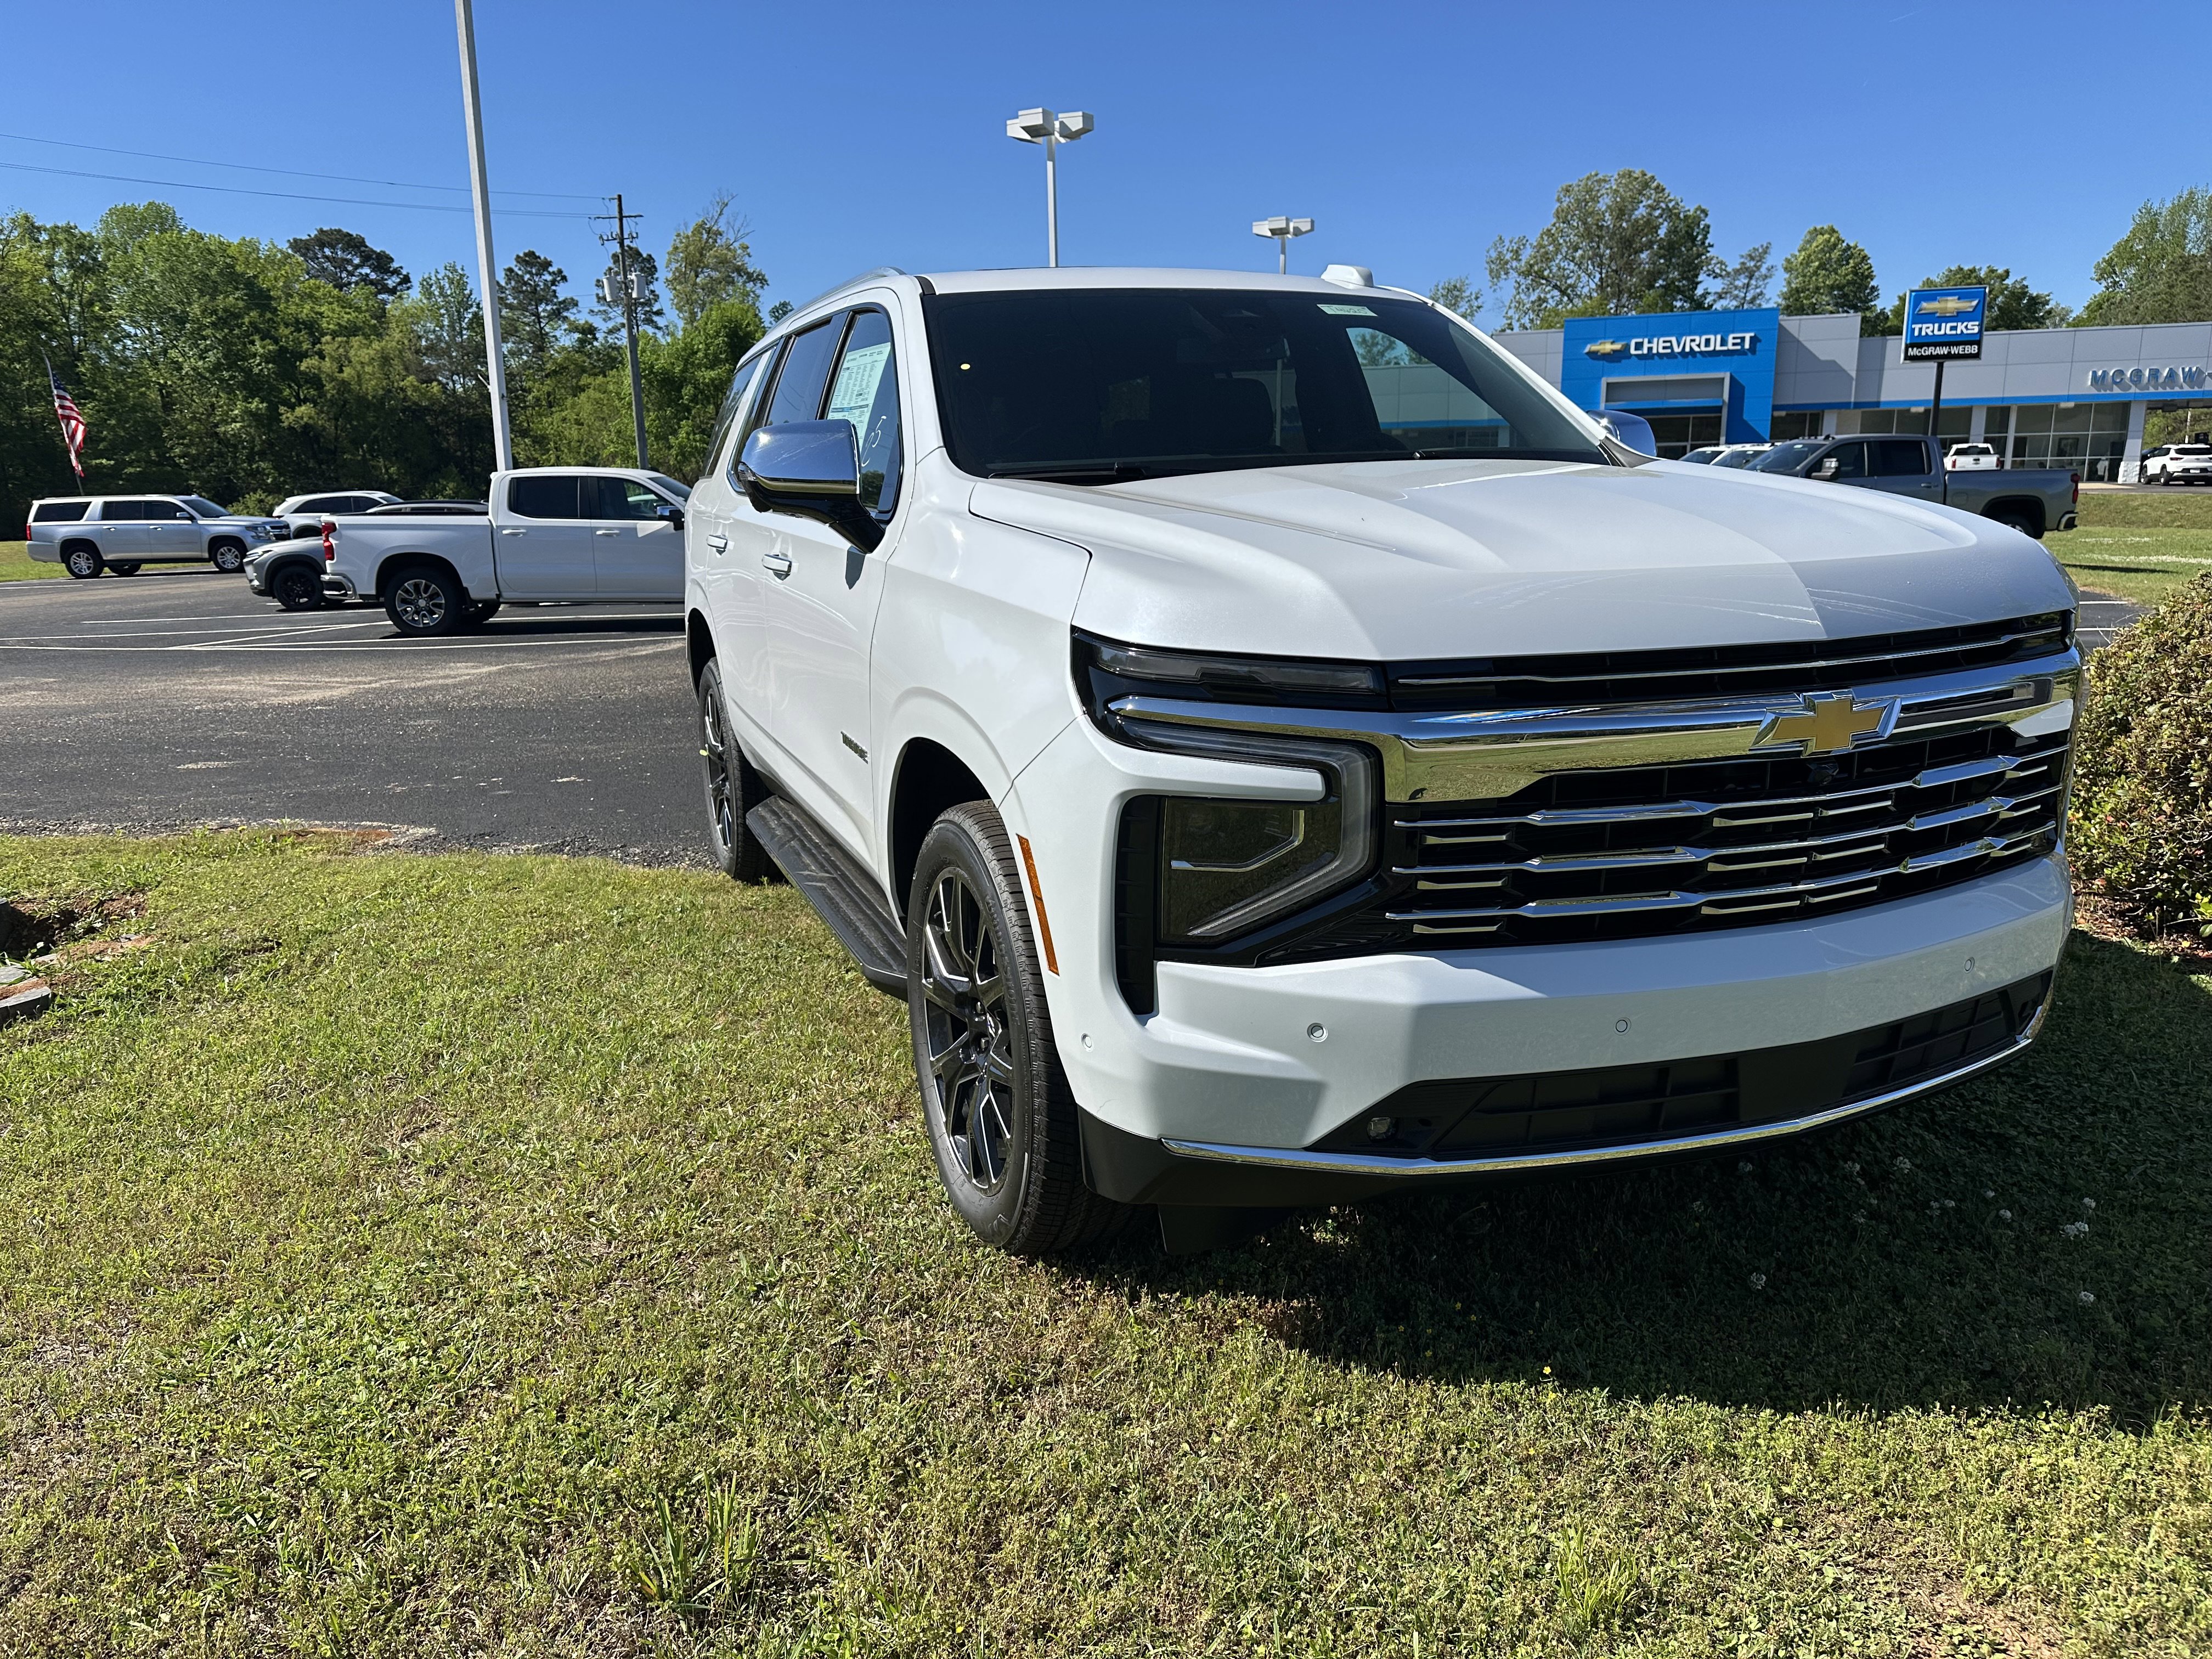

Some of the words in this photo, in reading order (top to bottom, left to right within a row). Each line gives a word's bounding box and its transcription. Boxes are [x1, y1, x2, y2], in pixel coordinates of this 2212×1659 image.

[1912, 321, 1979, 336] TRUCKS
[1630, 332, 1755, 355] CHEVROLET
[1908, 345, 1978, 356] McGRAW-WEBB
